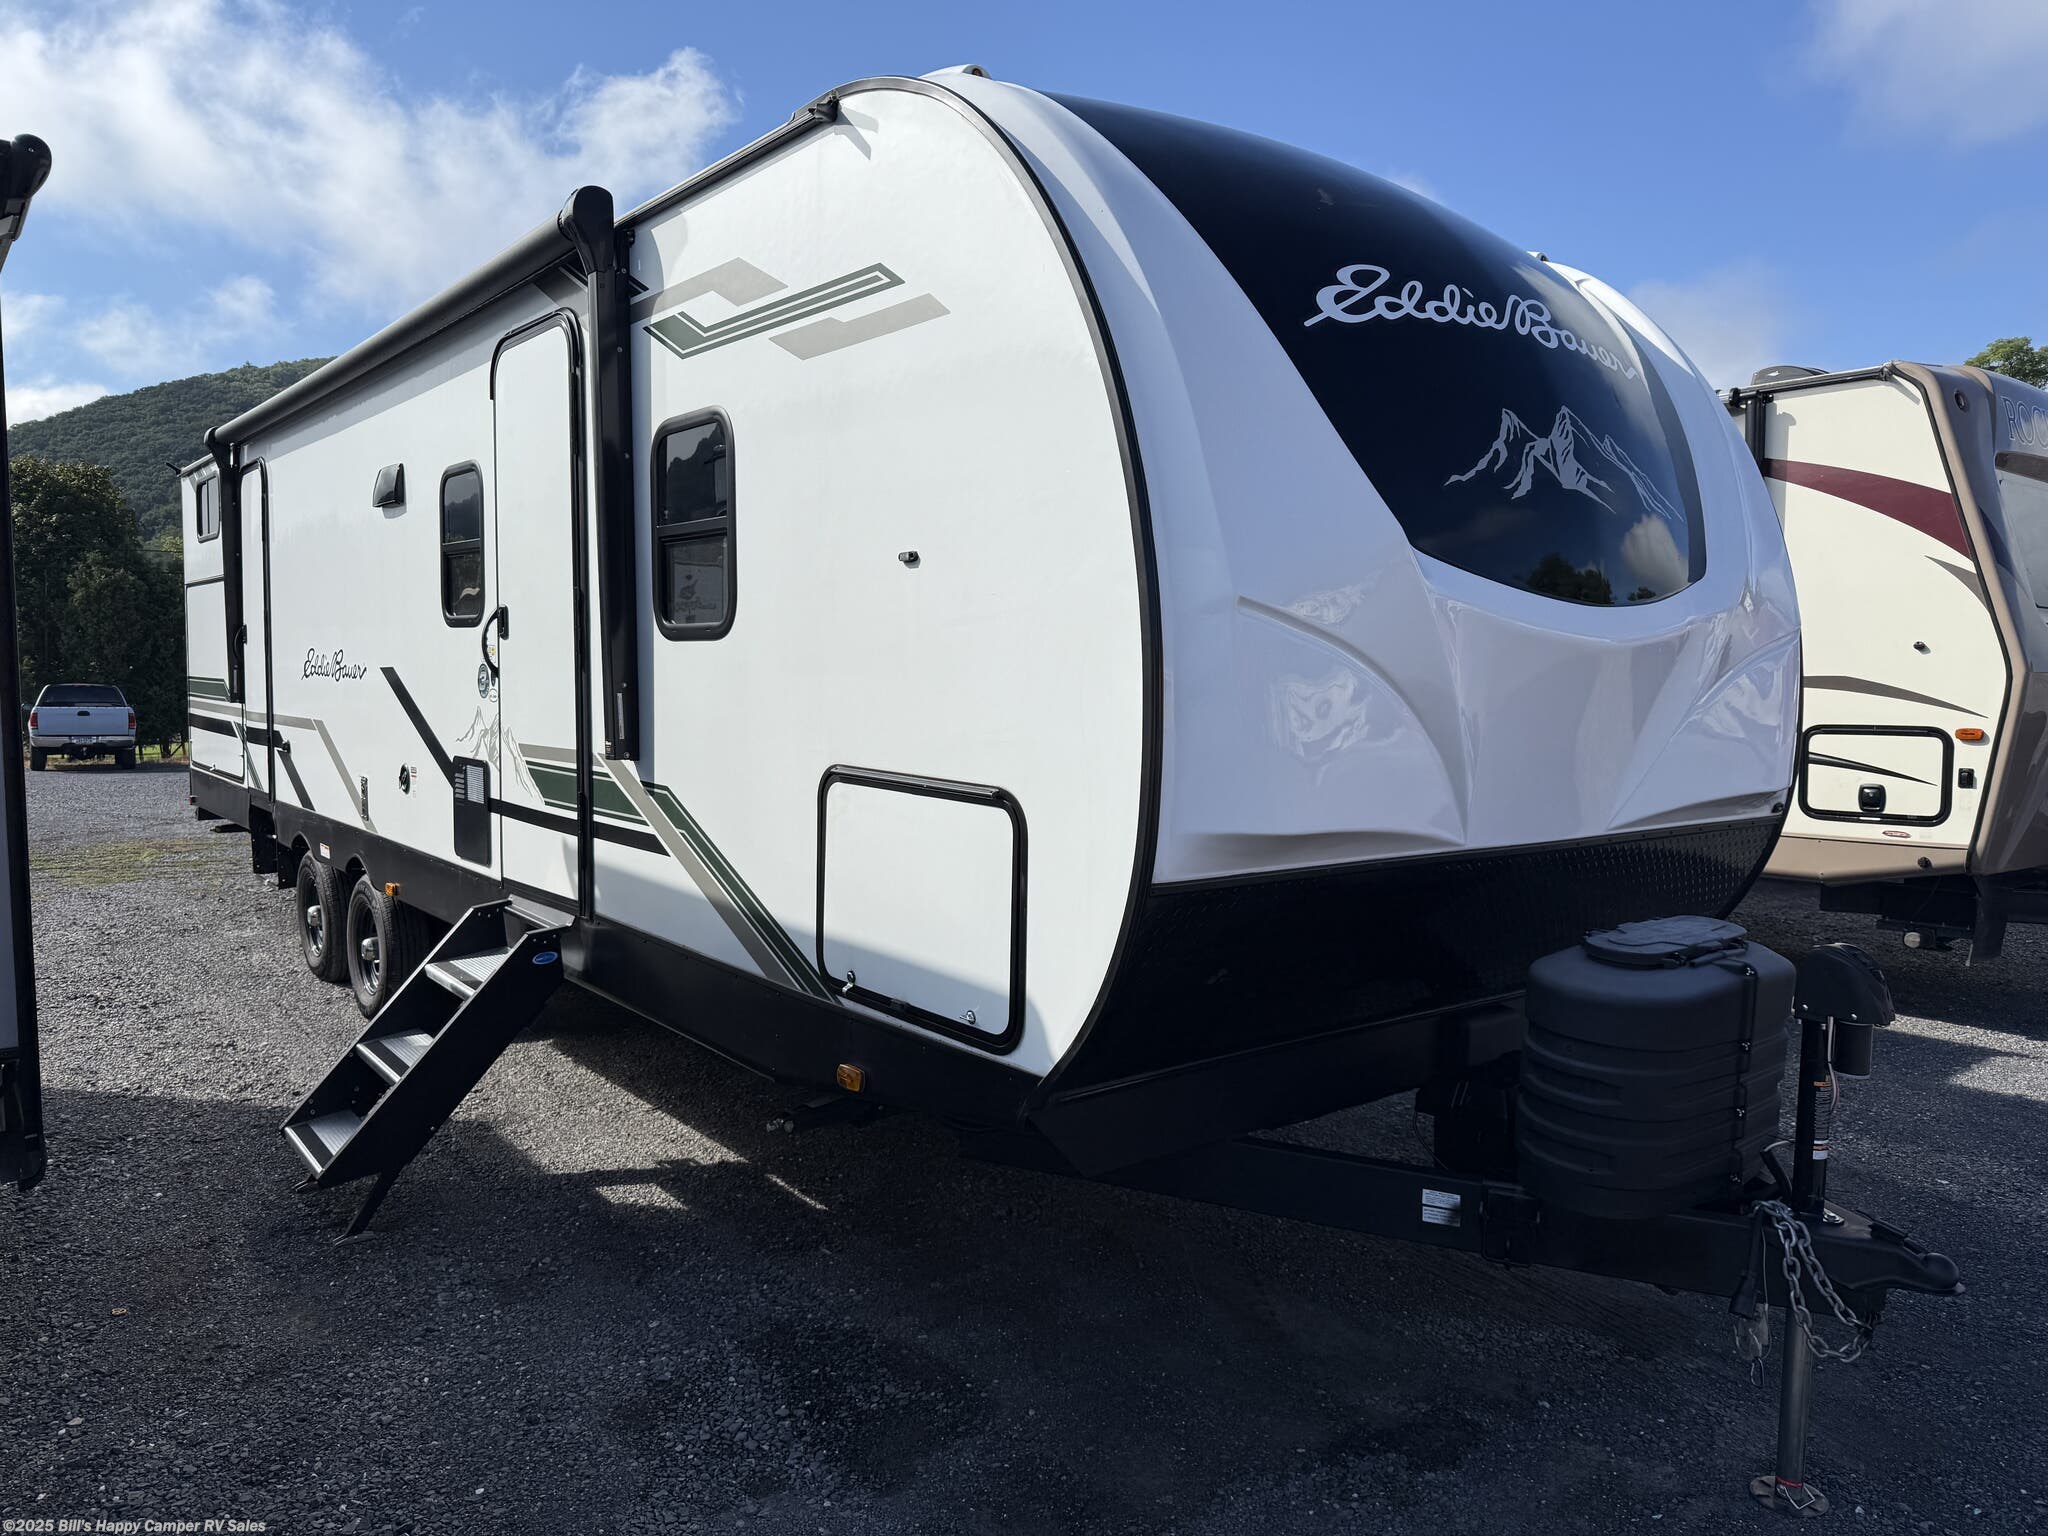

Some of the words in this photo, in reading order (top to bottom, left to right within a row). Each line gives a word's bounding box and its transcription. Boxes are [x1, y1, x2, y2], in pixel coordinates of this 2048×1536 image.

[1304, 264, 1508, 330] Eddie
[1505, 294, 1639, 380] Bauer
[301, 647, 332, 680] Eddie
[331, 649, 367, 682] Bauer
